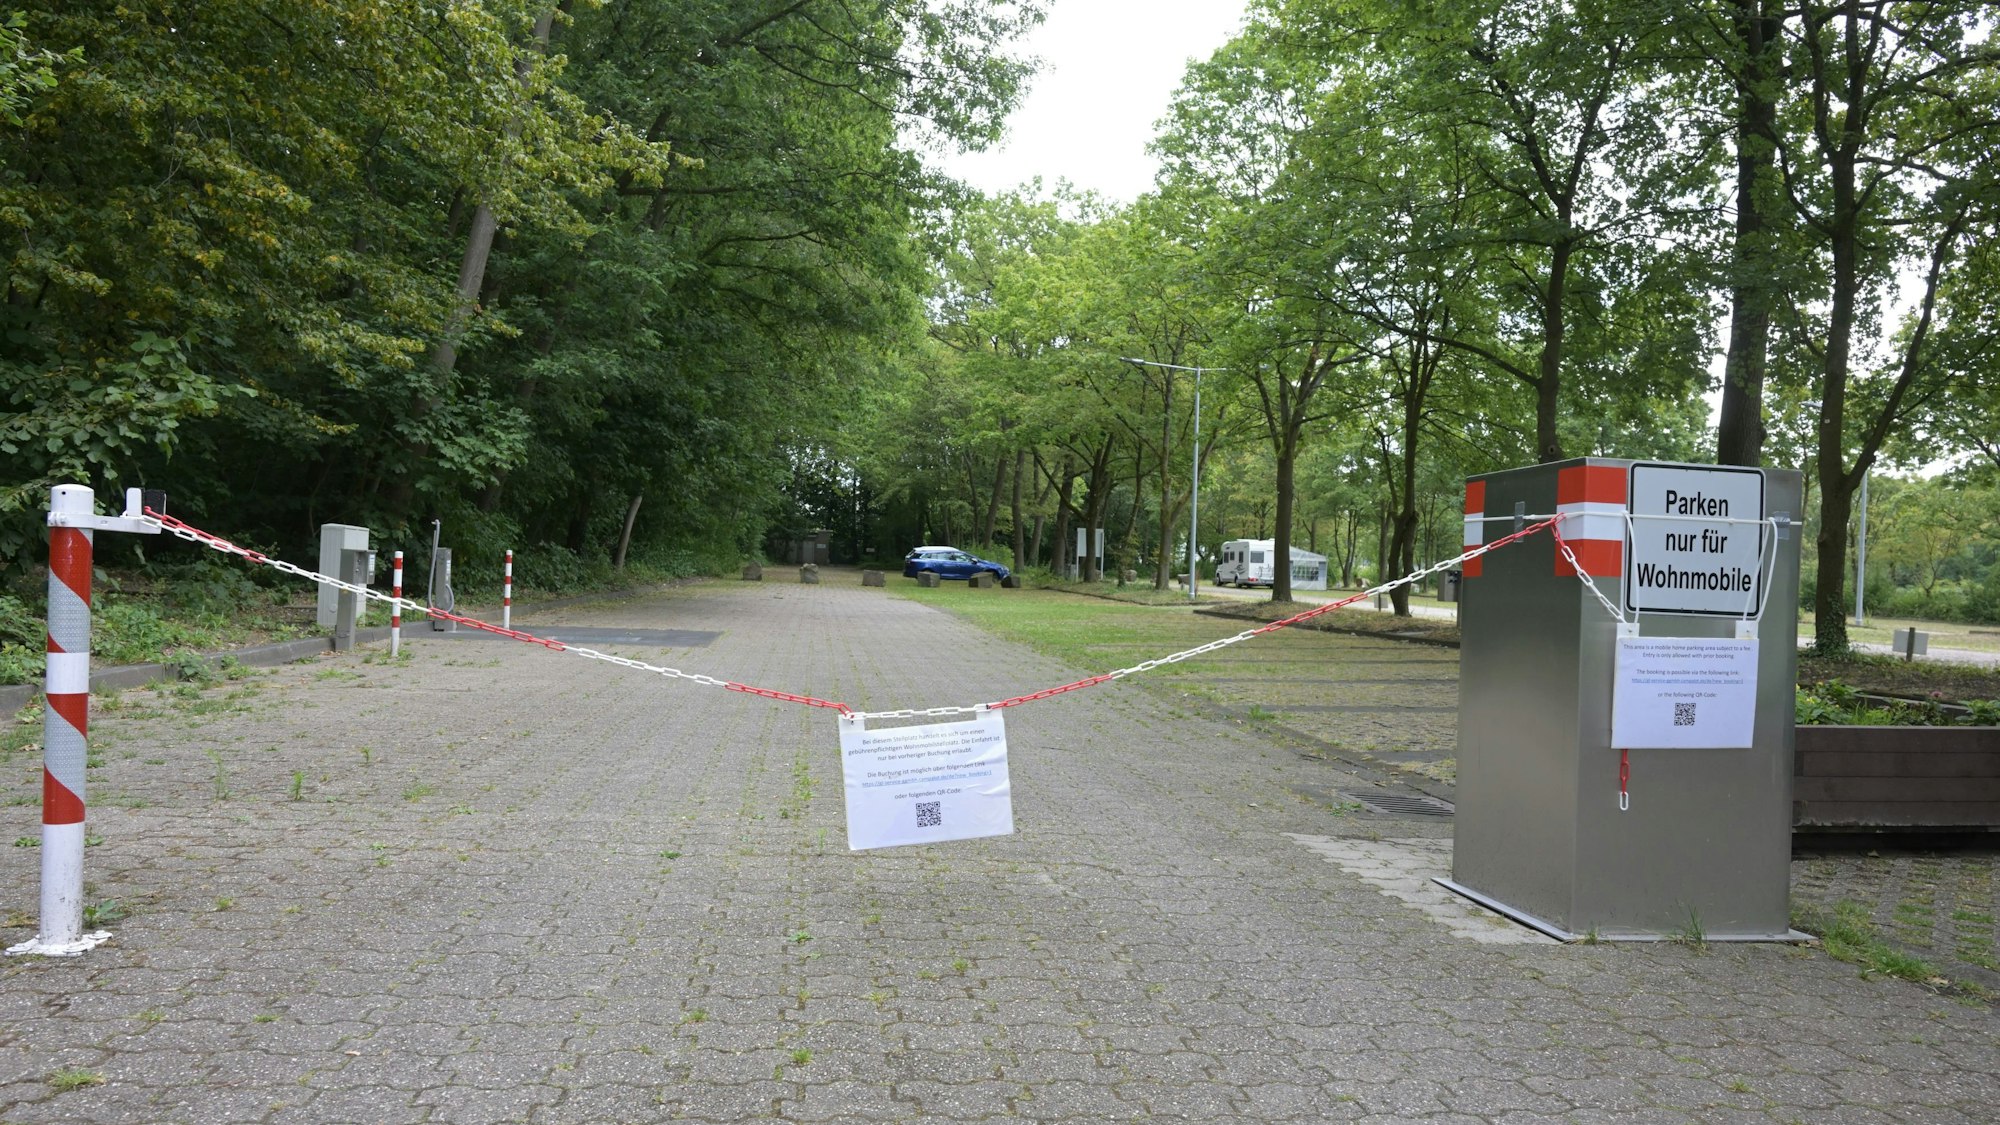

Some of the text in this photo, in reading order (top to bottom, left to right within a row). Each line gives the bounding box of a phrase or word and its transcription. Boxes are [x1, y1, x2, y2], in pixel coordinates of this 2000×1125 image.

[1666, 490, 1728, 517] Parken
[1666, 529, 1728, 554] nur für
[1637, 563, 1751, 592] Wohnmobile
[848, 746, 903, 756] gebührenpflichtigen
[911, 766, 932, 774] möglich
[947, 763, 974, 771] folgenden
[909, 790, 936, 798] folgenden
